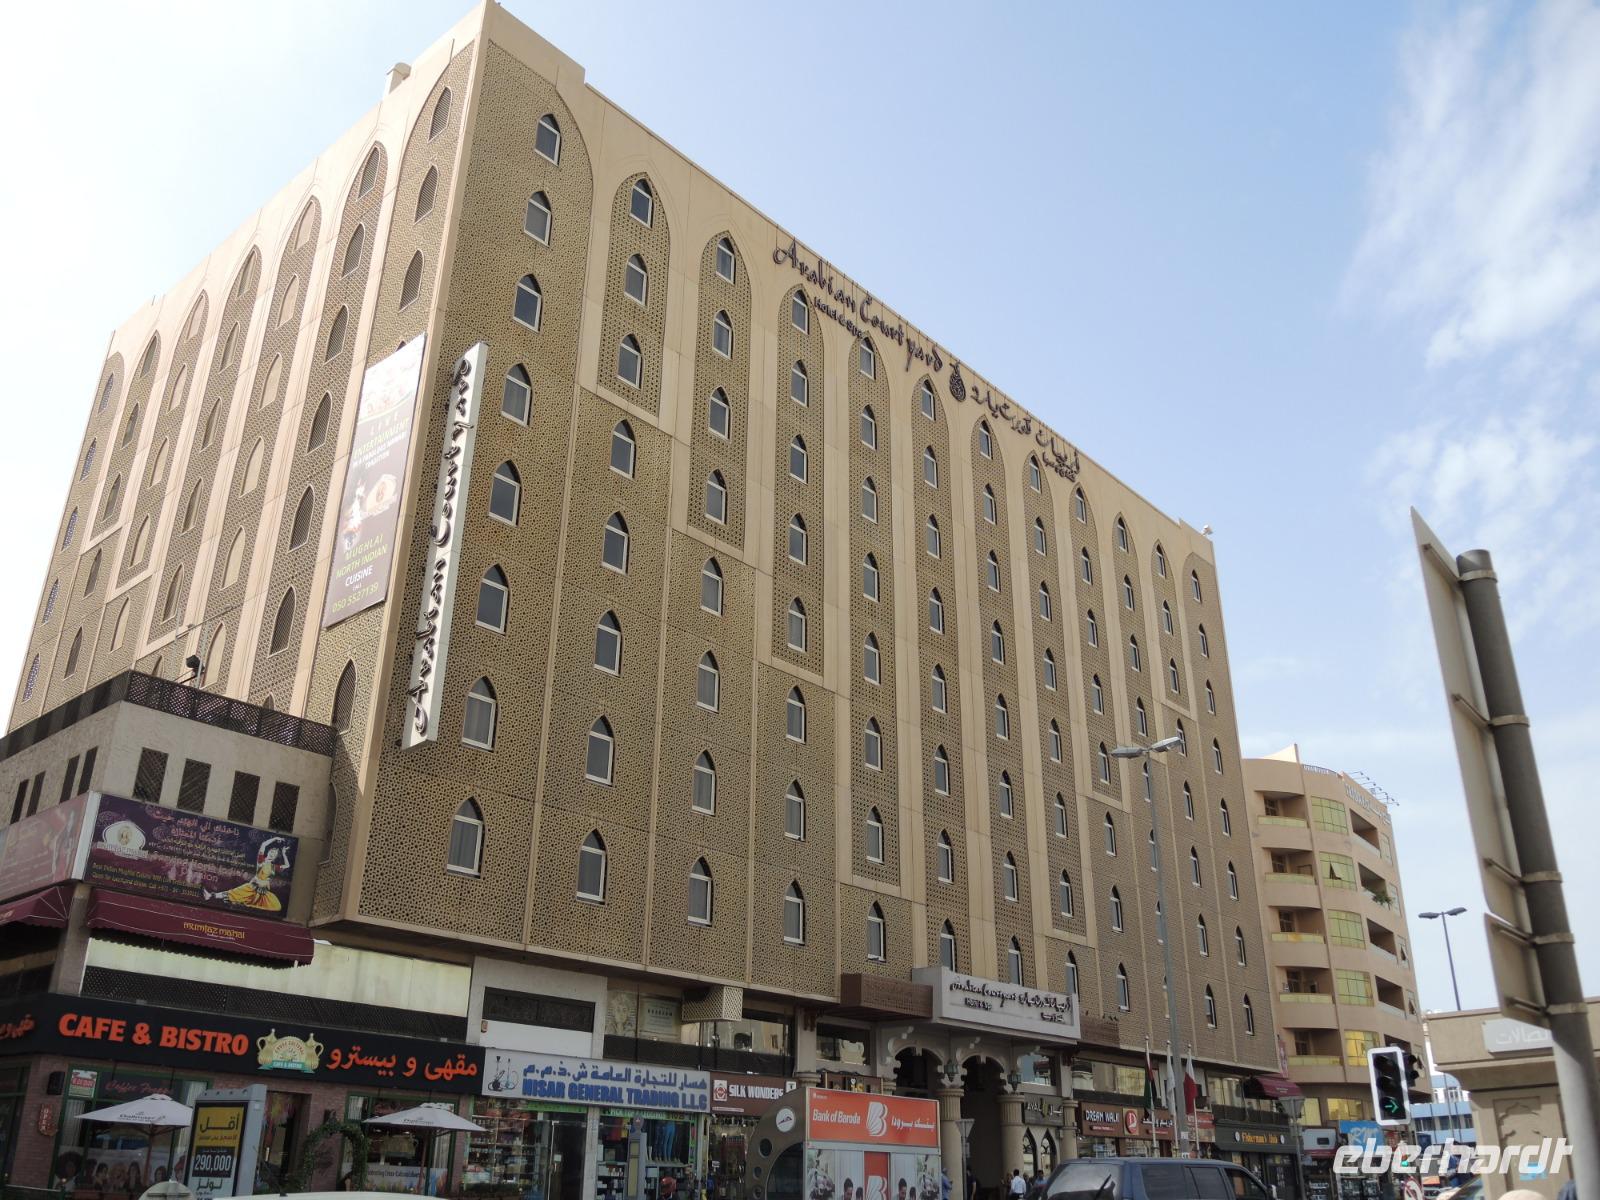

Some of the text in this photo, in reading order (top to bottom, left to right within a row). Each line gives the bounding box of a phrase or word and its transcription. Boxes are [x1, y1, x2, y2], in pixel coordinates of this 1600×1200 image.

[773, 238, 855, 313] Arabian
[345, 534, 383, 561] MUGHLAI
[336, 543, 388, 579] NORTH INDIAN
[345, 565, 374, 586] CUISINE
[58, 1013, 249, 1056] CAFE & BISTRO
[326, 1045, 478, 1081] مقهى و بيسترو
[591, 1064, 631, 1082] العامة
[634, 1069, 677, 1089] للتجارة
[522, 1078, 565, 1098] NISAR
[568, 1082, 624, 1104] GENERAL
[626, 1087, 679, 1108] TRADING
[729, 1084, 746, 1098] SILK
[812, 1109, 861, 1125] Bank of Baroda
[1085, 1110, 1104, 1122] DREAM
[194, 1154, 232, 1173] 290,000
